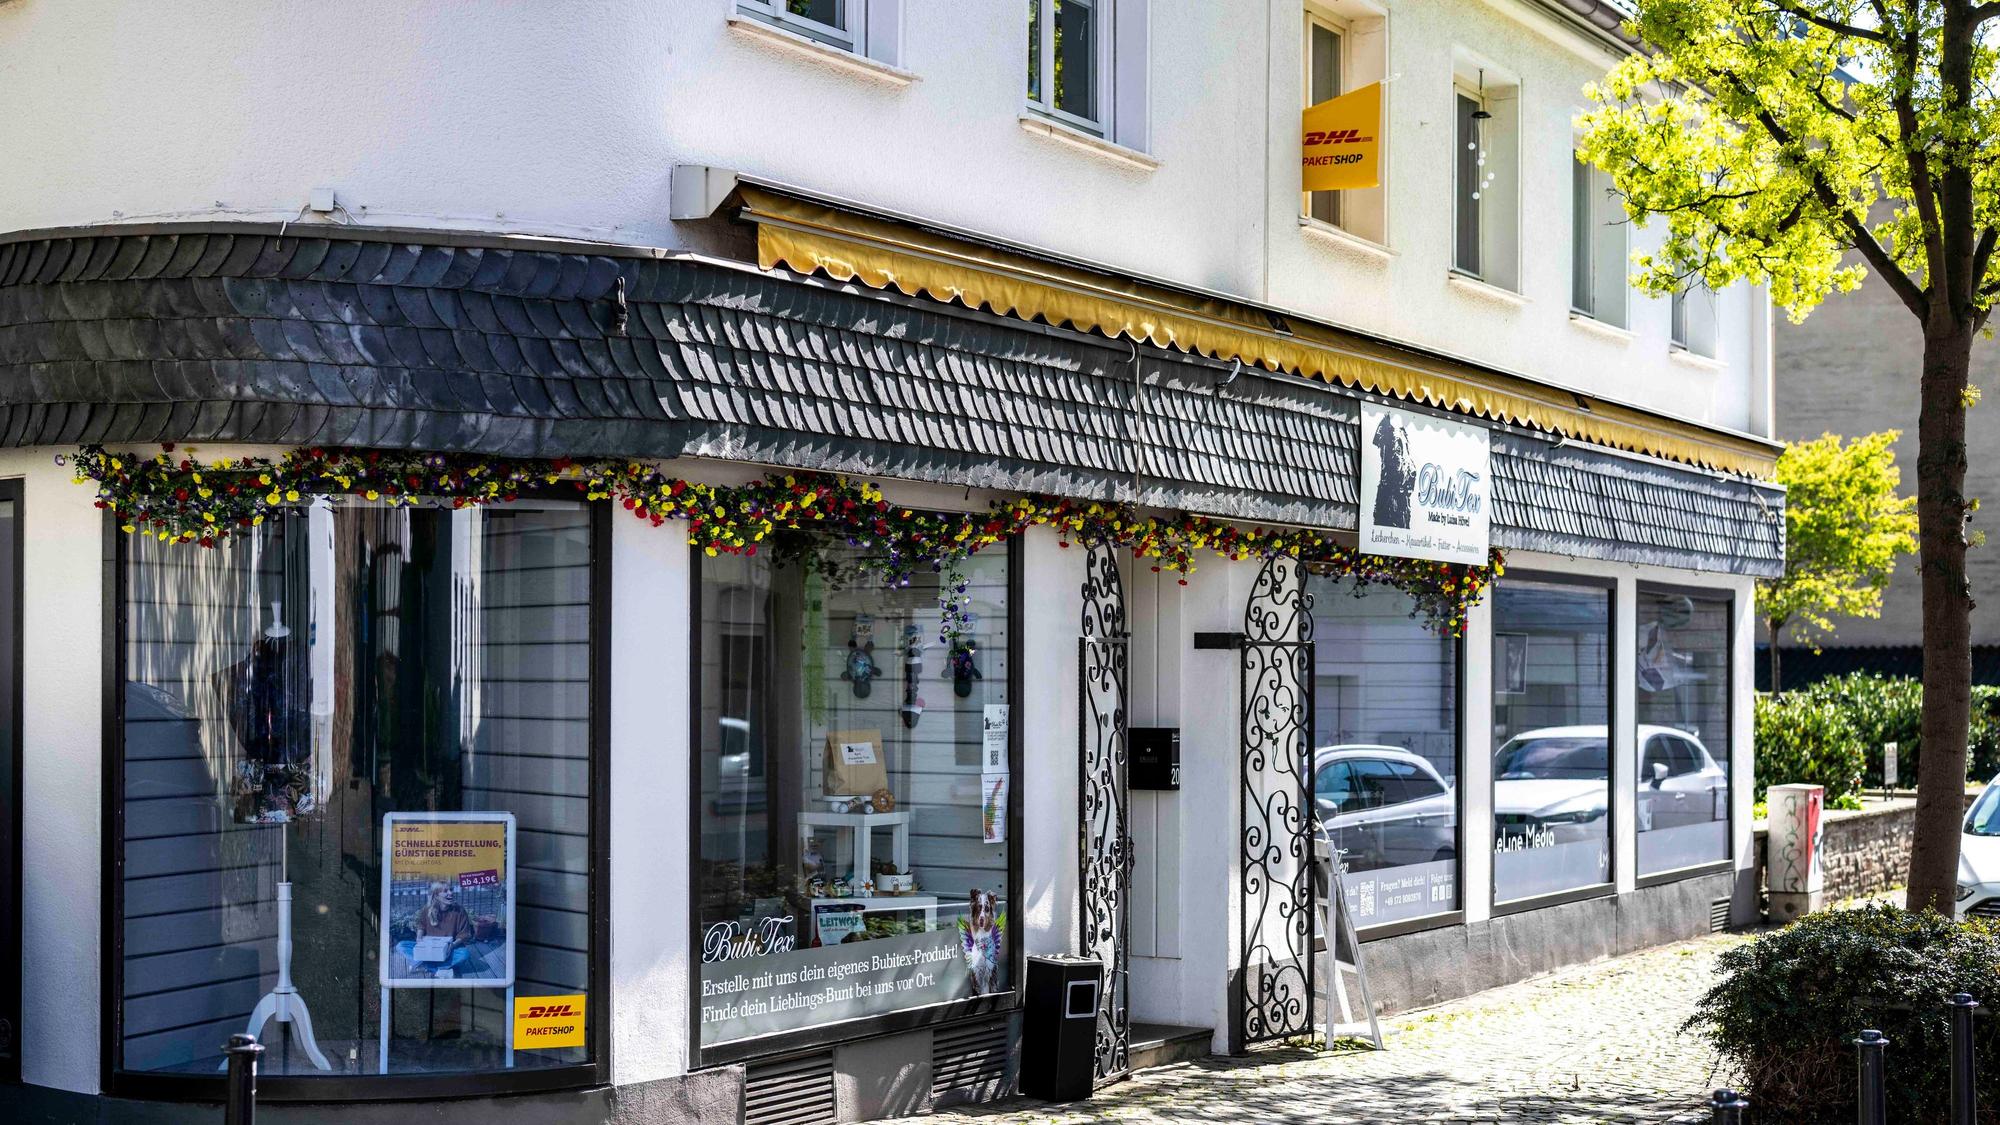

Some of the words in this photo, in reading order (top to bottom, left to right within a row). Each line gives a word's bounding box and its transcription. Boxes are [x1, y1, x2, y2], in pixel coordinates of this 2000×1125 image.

[1303, 129, 1362, 146] DHL
[1302, 153, 1363, 167] PAKETSHOP
[1171, 767, 1180, 785] 20
[395, 840, 440, 848] SCHNELLE
[442, 840, 502, 848] ZUSTELLUNG,
[1494, 827, 1523, 854] eLine
[1525, 822, 1555, 849] Media
[395, 849, 440, 857] GÜNSTIGE
[442, 849, 476, 857] PREISE.
[462, 877, 471, 886] ab
[473, 875, 497, 885] 4,19€
[702, 974, 750, 997] Erstelle
[752, 971, 773, 990] mit
[776, 971, 798, 986] uns
[800, 964, 825, 983] dein
[827, 961, 870, 981] eigenes
[871, 944, 958, 971] Bubitex-Produkt!
[702, 1003, 738, 1024] Finde
[740, 998, 767, 1017] dein
[770, 984, 854, 1013] Lieblings-Bunt
[855, 980, 872, 998] bei
[875, 981, 895, 995] uns
[896, 977, 915, 991] vor
[916, 972, 936, 988] Ort.
[528, 1005, 574, 1018] DHL
[526, 1025, 575, 1036] PAKETSHOP
